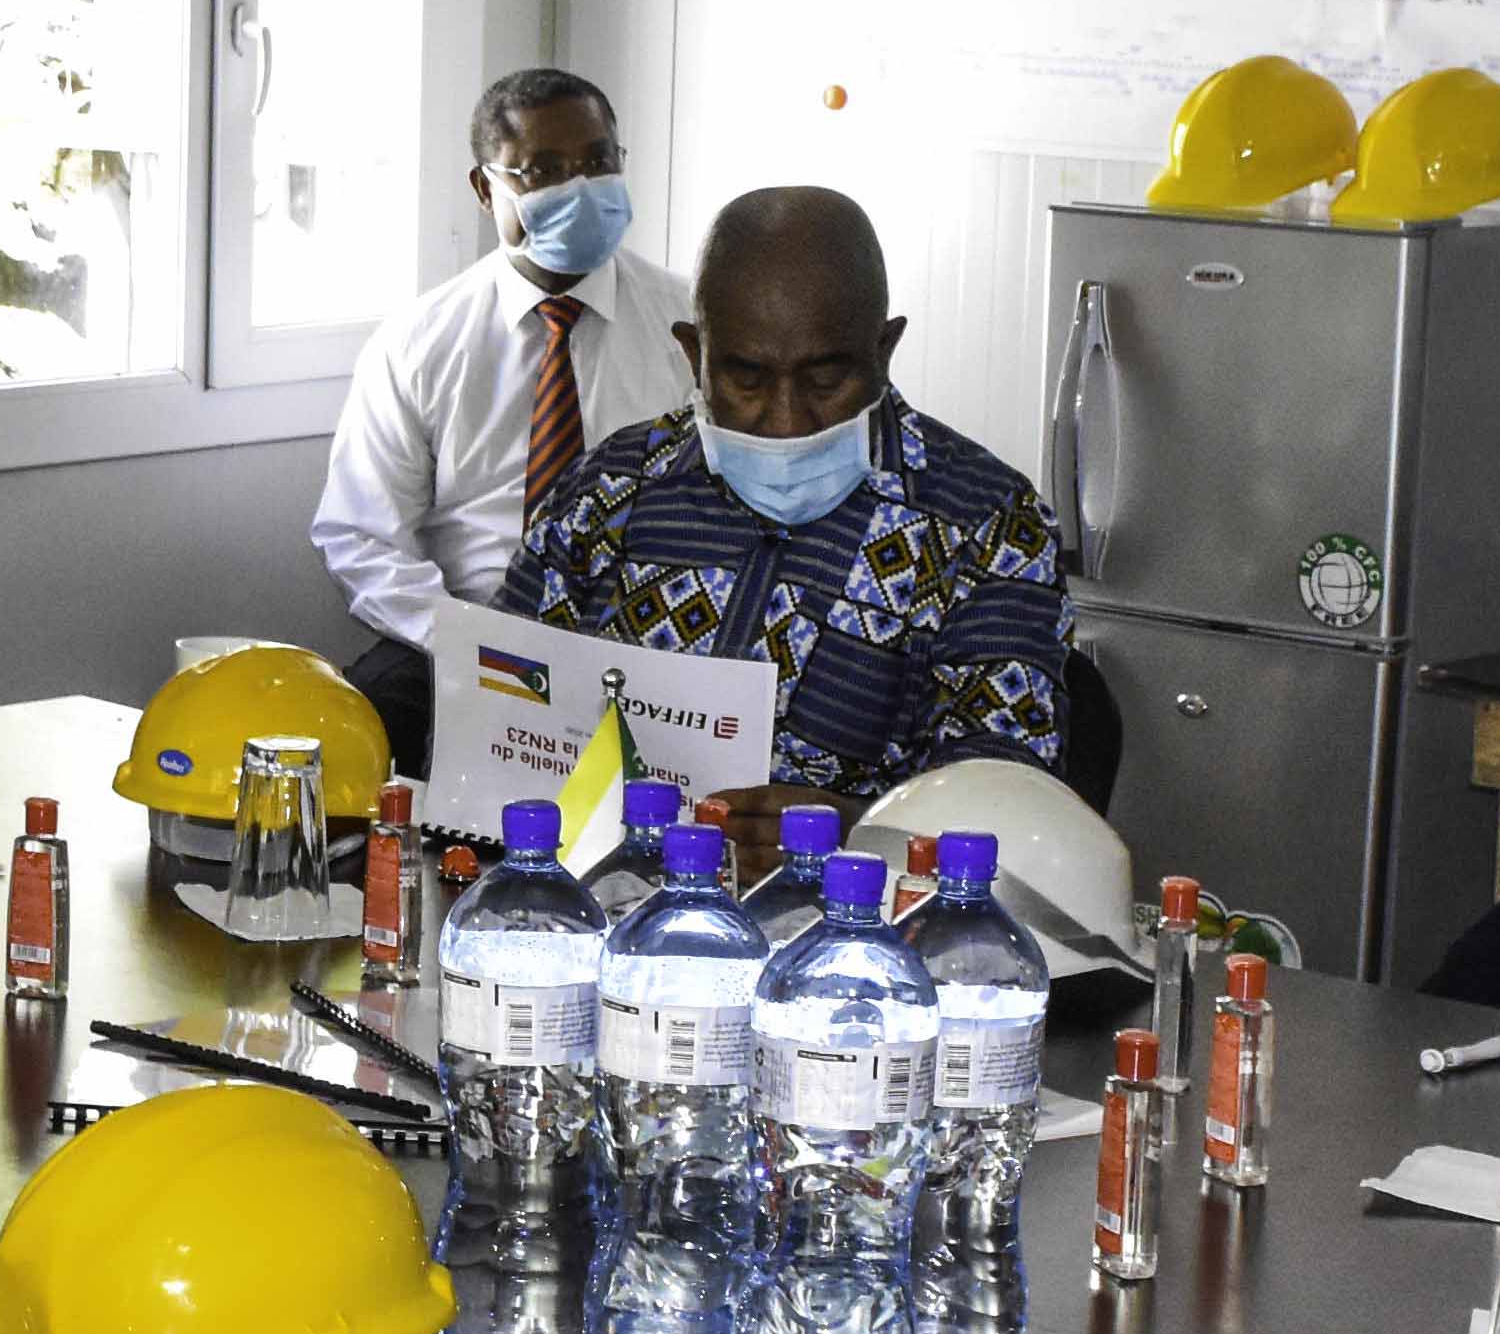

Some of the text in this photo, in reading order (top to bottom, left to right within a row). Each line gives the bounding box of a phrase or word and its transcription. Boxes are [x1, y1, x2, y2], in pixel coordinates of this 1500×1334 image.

[1301, 541, 1326, 569] 100
[1355, 546, 1380, 582] CFC
[1310, 603, 1368, 627] FREE
[620, 697, 708, 729] EIFFAGE
[491, 743, 514, 762] du
[506, 727, 556, 754] RN23
[563, 741, 579, 760] la
